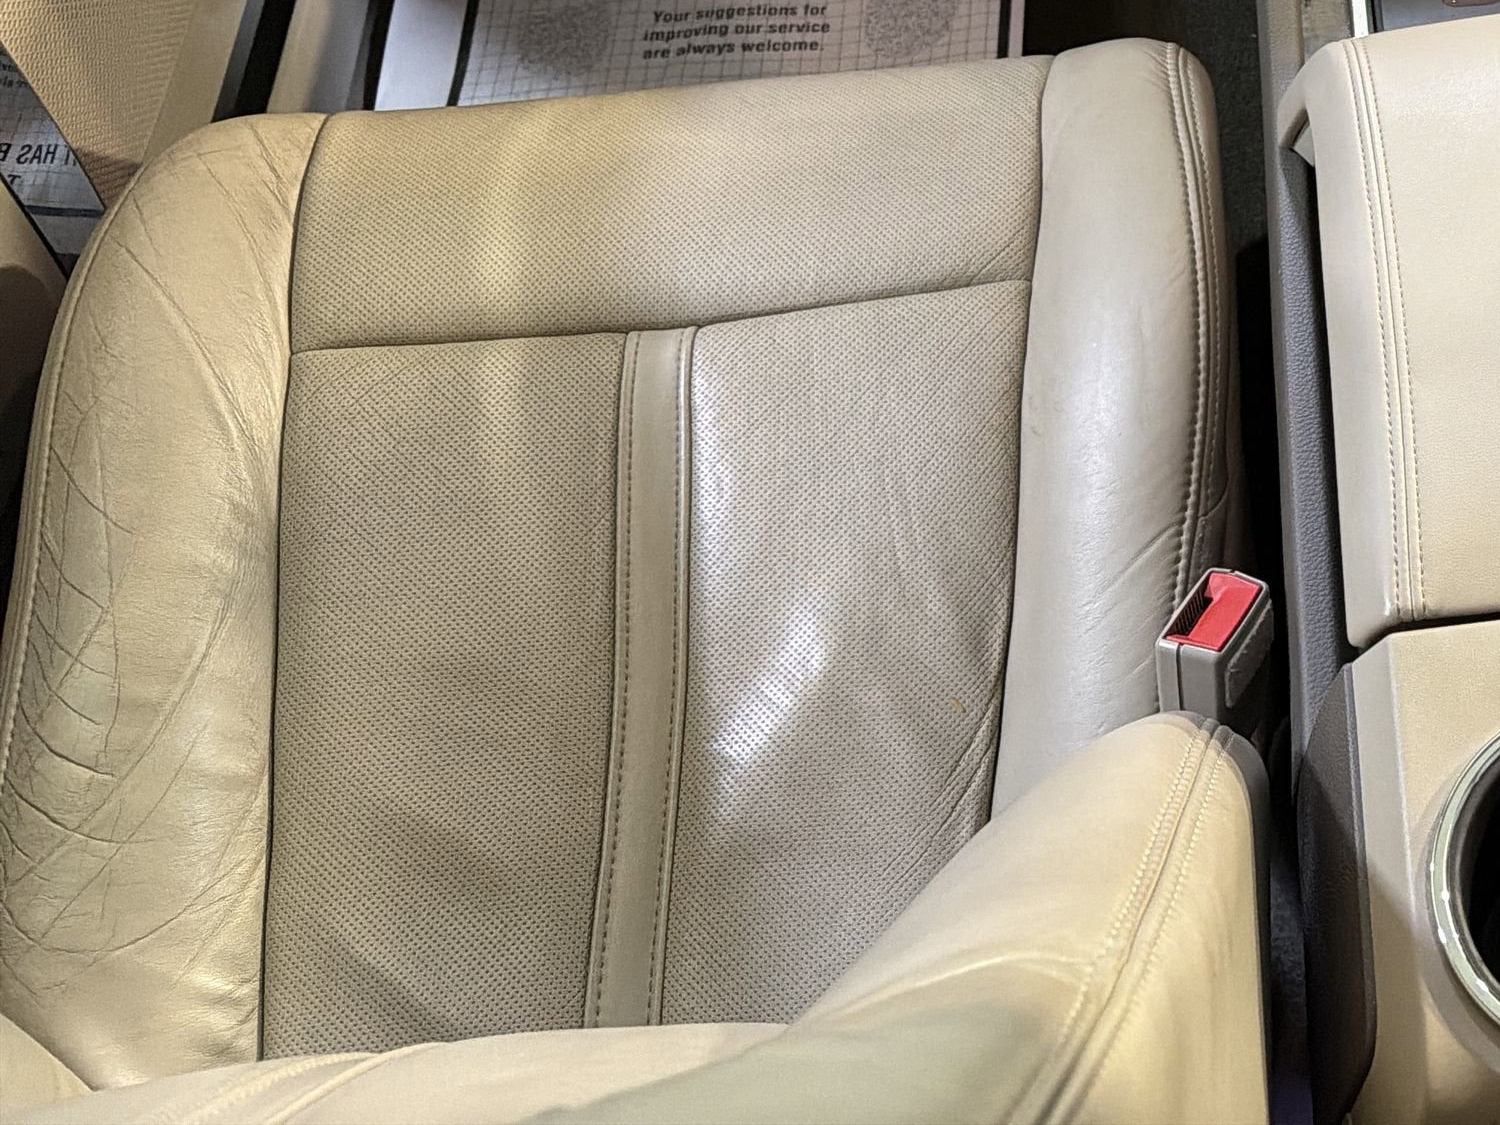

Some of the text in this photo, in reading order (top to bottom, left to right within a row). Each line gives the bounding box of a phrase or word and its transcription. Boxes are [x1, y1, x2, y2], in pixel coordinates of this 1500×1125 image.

[652, 3, 828, 24] Your suggestions for
[643, 21, 831, 43] improving our service
[643, 47, 671, 60] are
[676, 40, 735, 57] always
